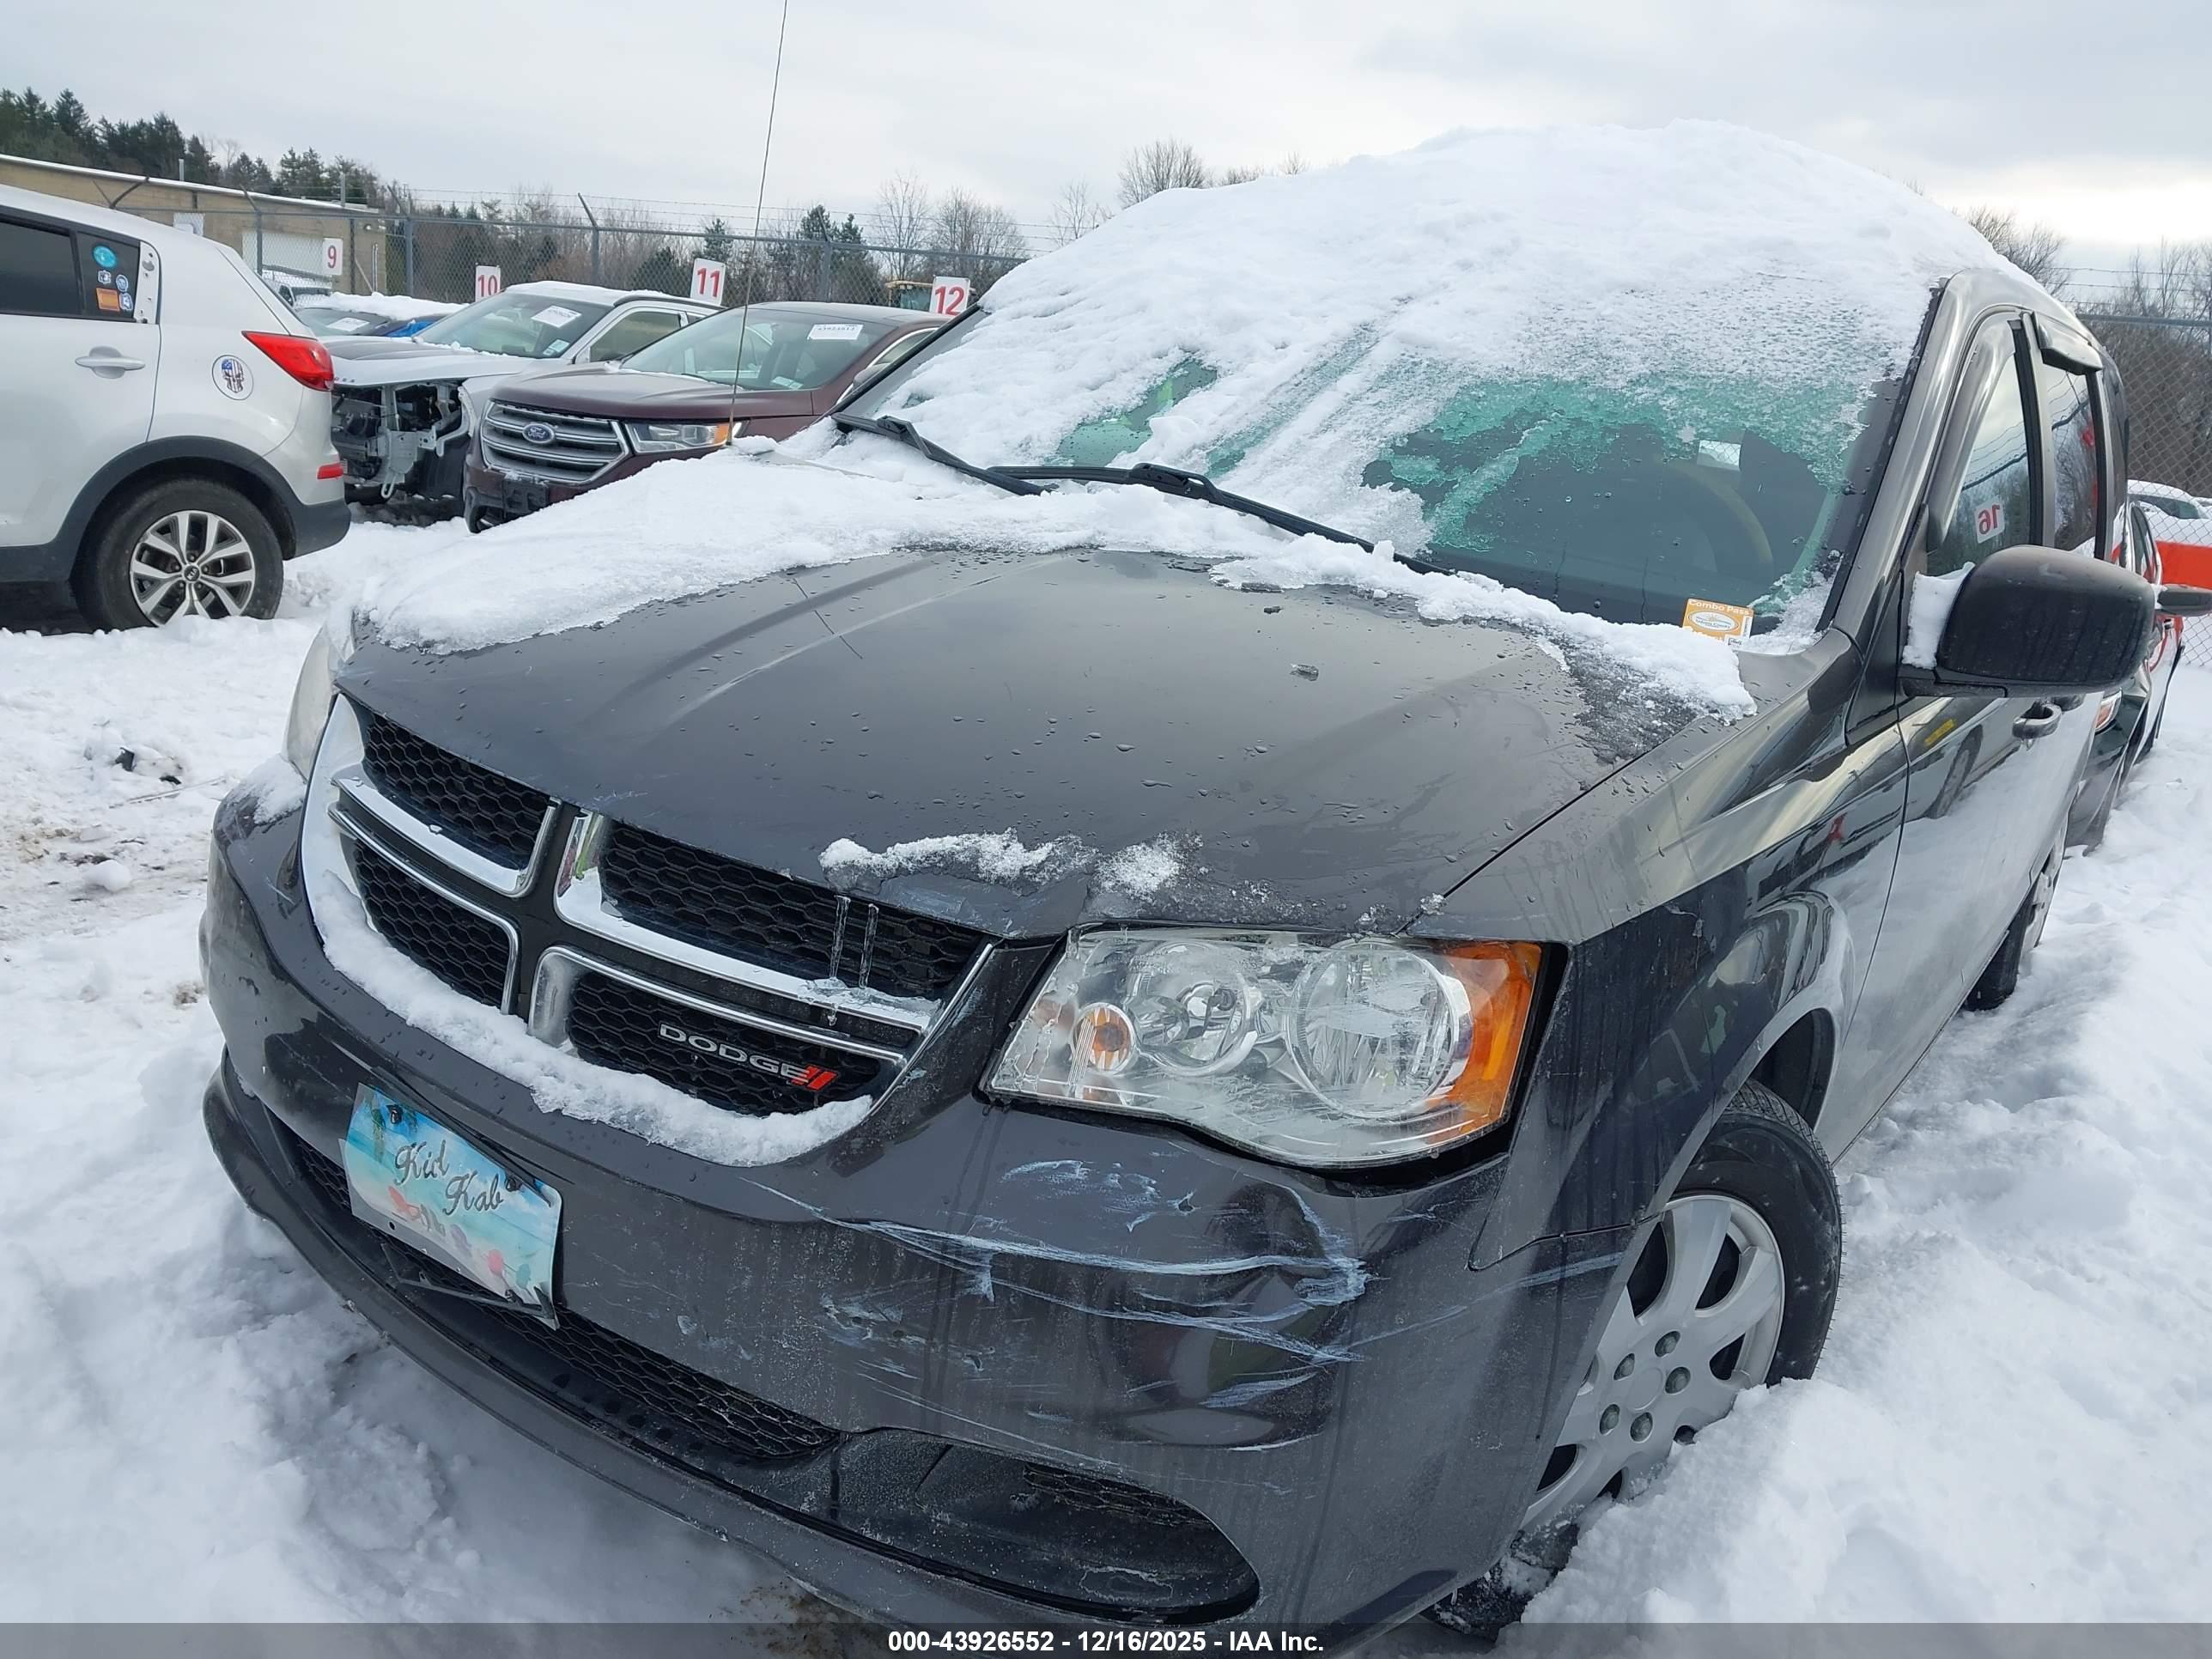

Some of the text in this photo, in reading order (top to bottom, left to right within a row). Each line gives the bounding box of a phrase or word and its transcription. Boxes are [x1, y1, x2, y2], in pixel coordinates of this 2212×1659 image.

[328, 245, 337, 268] 9
[477, 275, 497, 297] 10
[697, 268, 720, 298] 11
[935, 286, 964, 316] 12
[1688, 599, 1749, 615] Combo Pass
[659, 1024, 811, 1084] DODGE
[394, 1139, 450, 1186] Kid
[442, 1170, 504, 1216] Kab
